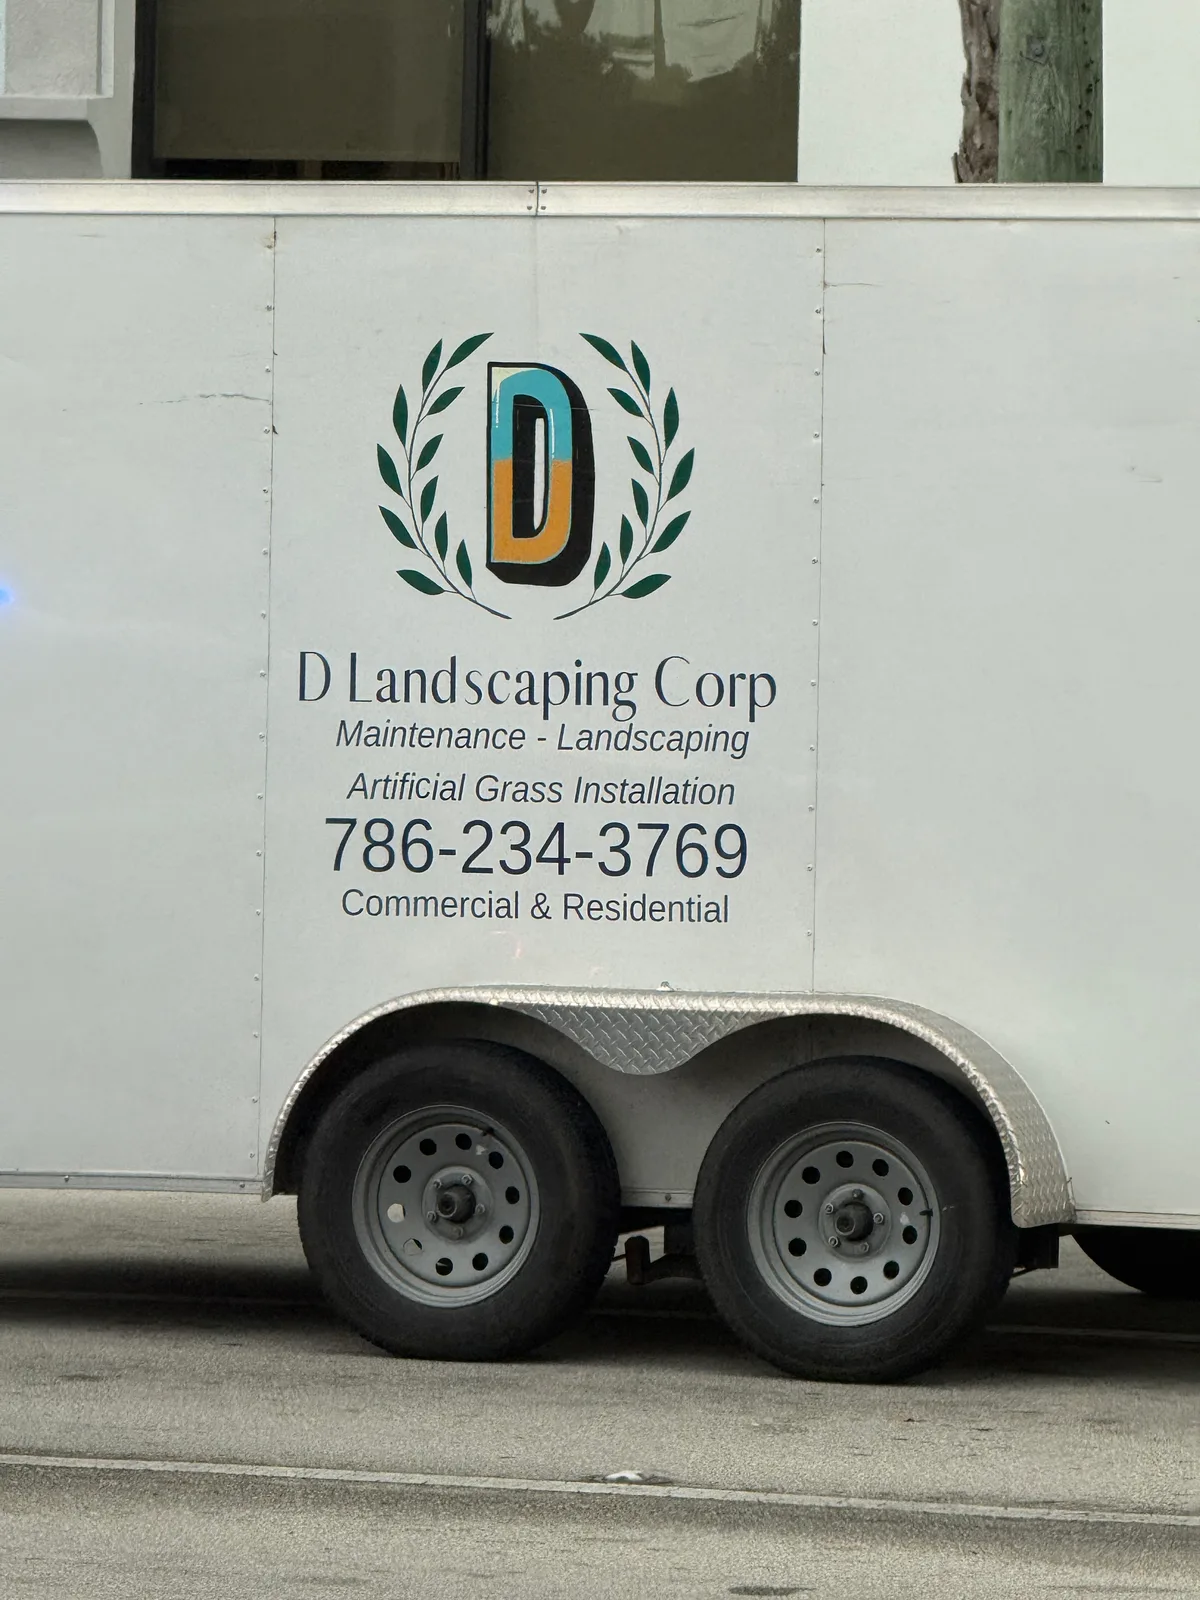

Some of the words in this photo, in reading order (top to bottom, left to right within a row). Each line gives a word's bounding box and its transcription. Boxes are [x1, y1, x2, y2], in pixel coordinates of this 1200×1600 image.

[486, 362, 595, 587] D
[298, 651, 331, 702] D
[349, 652, 639, 722] Landscaping
[654, 655, 777, 723] Corp
[336, 718, 526, 750] Maintenance
[557, 722, 750, 760] Landscaping
[347, 771, 466, 802] Artificial
[476, 774, 563, 804] Grass
[574, 776, 735, 806] Installation
[325, 817, 748, 879] 786-234-3769
[341, 888, 519, 919] Commercial
[530, 892, 552, 920] &
[563, 892, 729, 924] Residential
